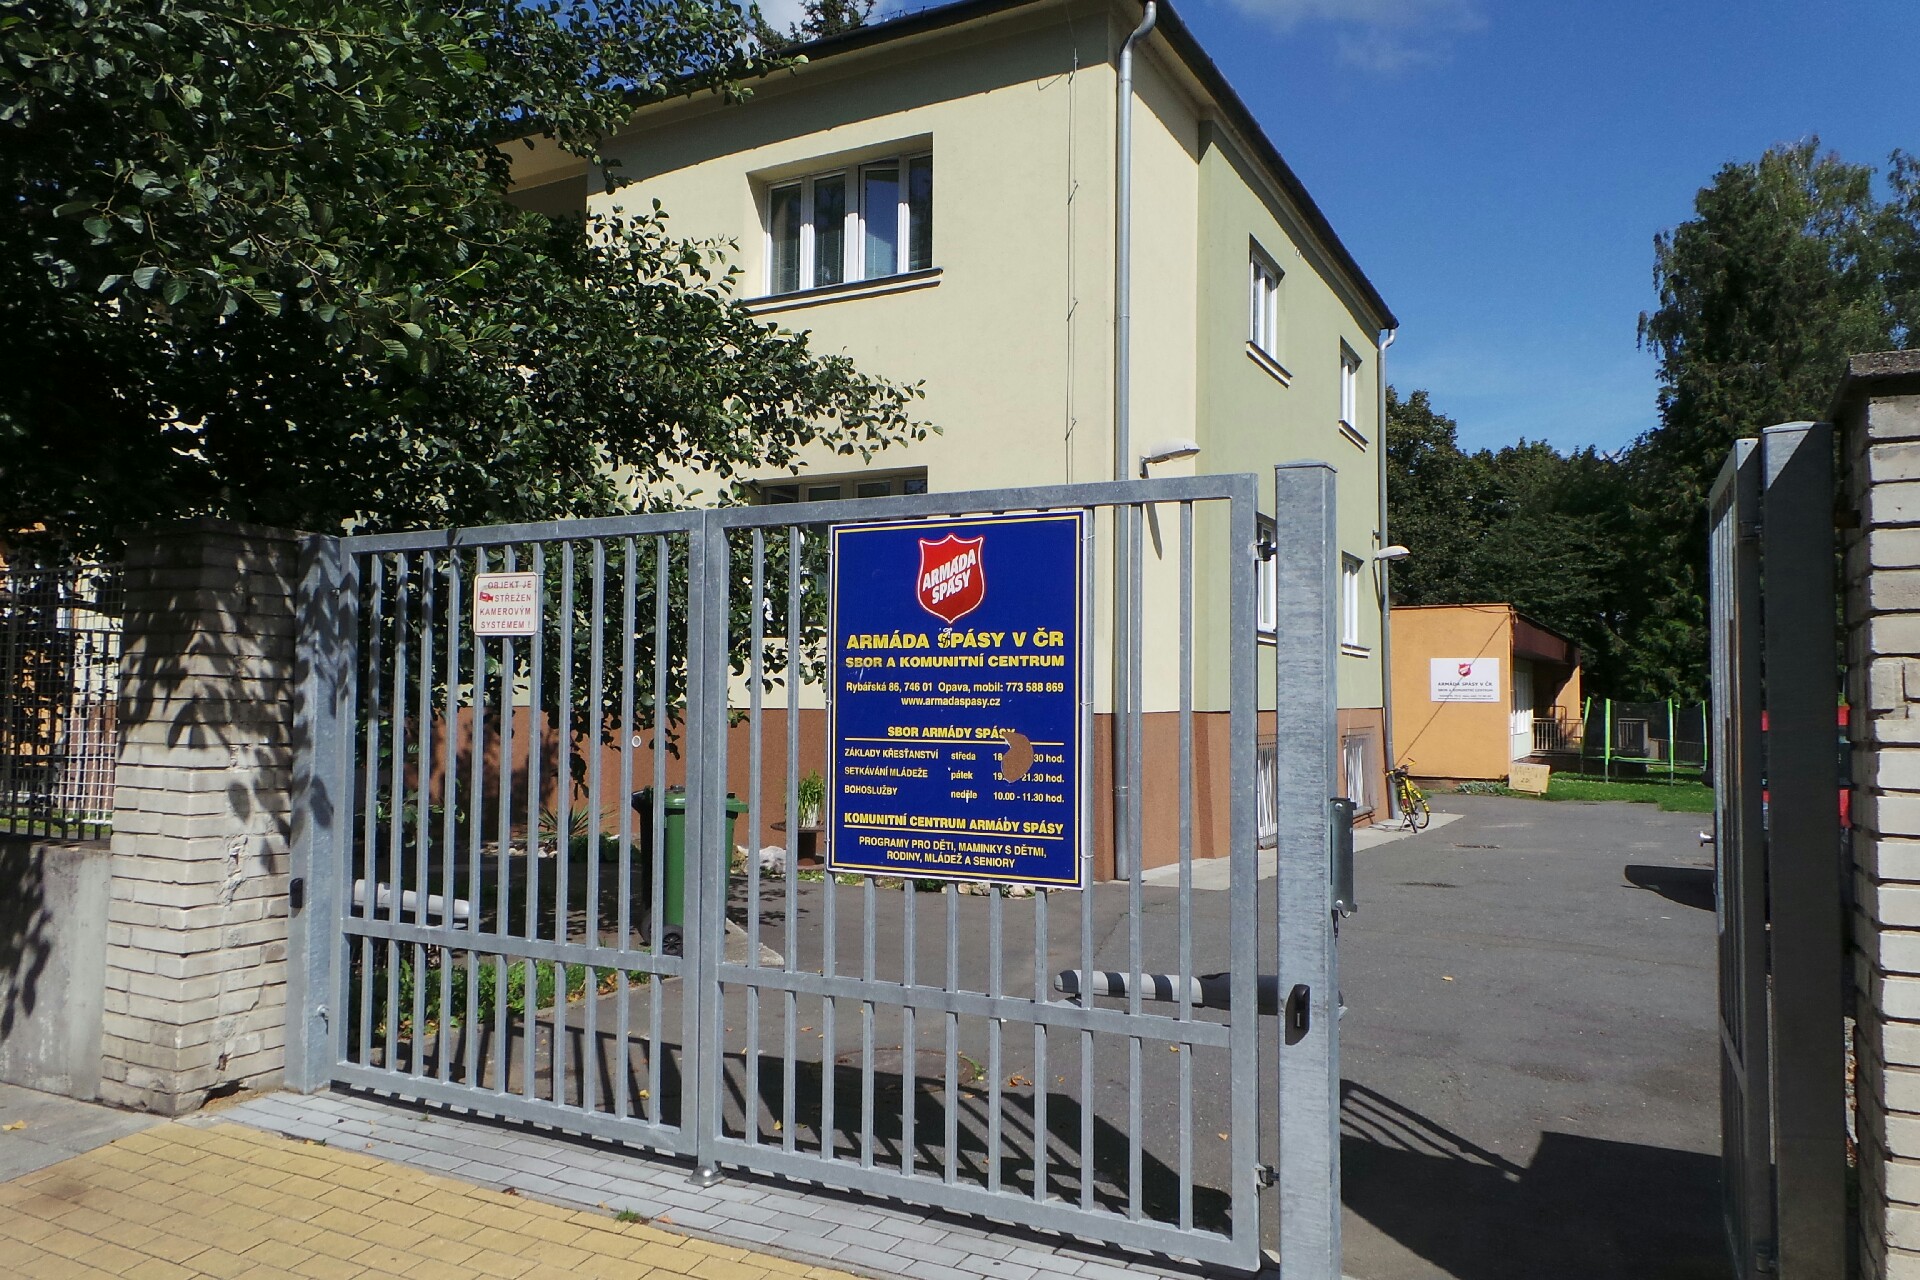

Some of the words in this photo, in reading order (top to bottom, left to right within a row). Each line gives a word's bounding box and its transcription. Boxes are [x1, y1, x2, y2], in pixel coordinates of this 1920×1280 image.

[922, 549, 976, 591] ARMÁDA
[488, 581, 519, 589] OBJEKT
[494, 592, 531, 602] STŘEŽEN
[480, 605, 531, 615] KAMEROVÝM
[846, 630, 930, 648] ARMÁDA
[937, 628, 1005, 648] SPÁSY
[1012, 631, 1027, 647] V
[1033, 627, 1064, 647] ČR
[845, 656, 882, 668] SBOR
[886, 657, 896, 667] A
[900, 653, 984, 667] KOMUNITNÍ
[987, 655, 1064, 667] CENTRUM
[846, 681, 886, 694] Rybářská
[888, 682, 902, 693] 86,
[904, 682, 920, 692] 746
[922, 682, 932, 692] 01
[938, 682, 971, 694] Opava,
[973, 682, 1004, 692] mobil:
[1005, 682, 1023, 692] 773
[1026, 682, 1043, 692] 588
[1046, 682, 1064, 692] 869
[901, 696, 1001, 708] www.armadaspasy.cz
[888, 726, 919, 737] SBOR
[922, 725, 972, 738] ARMÁDY
[844, 747, 880, 758] ZÁKLADY
[883, 748, 938, 759] KŘESŤANSTVÍ
[951, 752, 976, 760] středa
[1046, 754, 1064, 763] hod.
[844, 765, 888, 776] SETKÁVÁNÍ
[890, 767, 928, 778] MLÁDEŽE
[951, 770, 973, 780] pátek
[1046, 774, 1064, 783] hod.
[844, 784, 897, 795] BOHOSLUŽBY
[951, 790, 978, 799] neděle
[993, 792, 1015, 800] 10.00
[1022, 793, 1044, 802] 11.30
[1046, 793, 1064, 803] hod.
[844, 812, 907, 826] KOMUNITNÍ
[909, 816, 966, 829] CENTRUM
[970, 818, 1020, 832] ARMÁDY
[1023, 820, 1064, 834] SPÁSY
[859, 836, 910, 848] PROGRAMY
[911, 839, 931, 850] PRO
[933, 839, 956, 853] DĚTI,
[958, 842, 1003, 854] MAMINKY
[1005, 845, 1012, 854] S
[1014, 844, 1047, 858] DĚTMI,
[887, 850, 923, 863] RODINY,
[924, 852, 963, 864] MLÁDEŽ
[964, 856, 971, 864] A
[973, 856, 1015, 868] SENIORY
